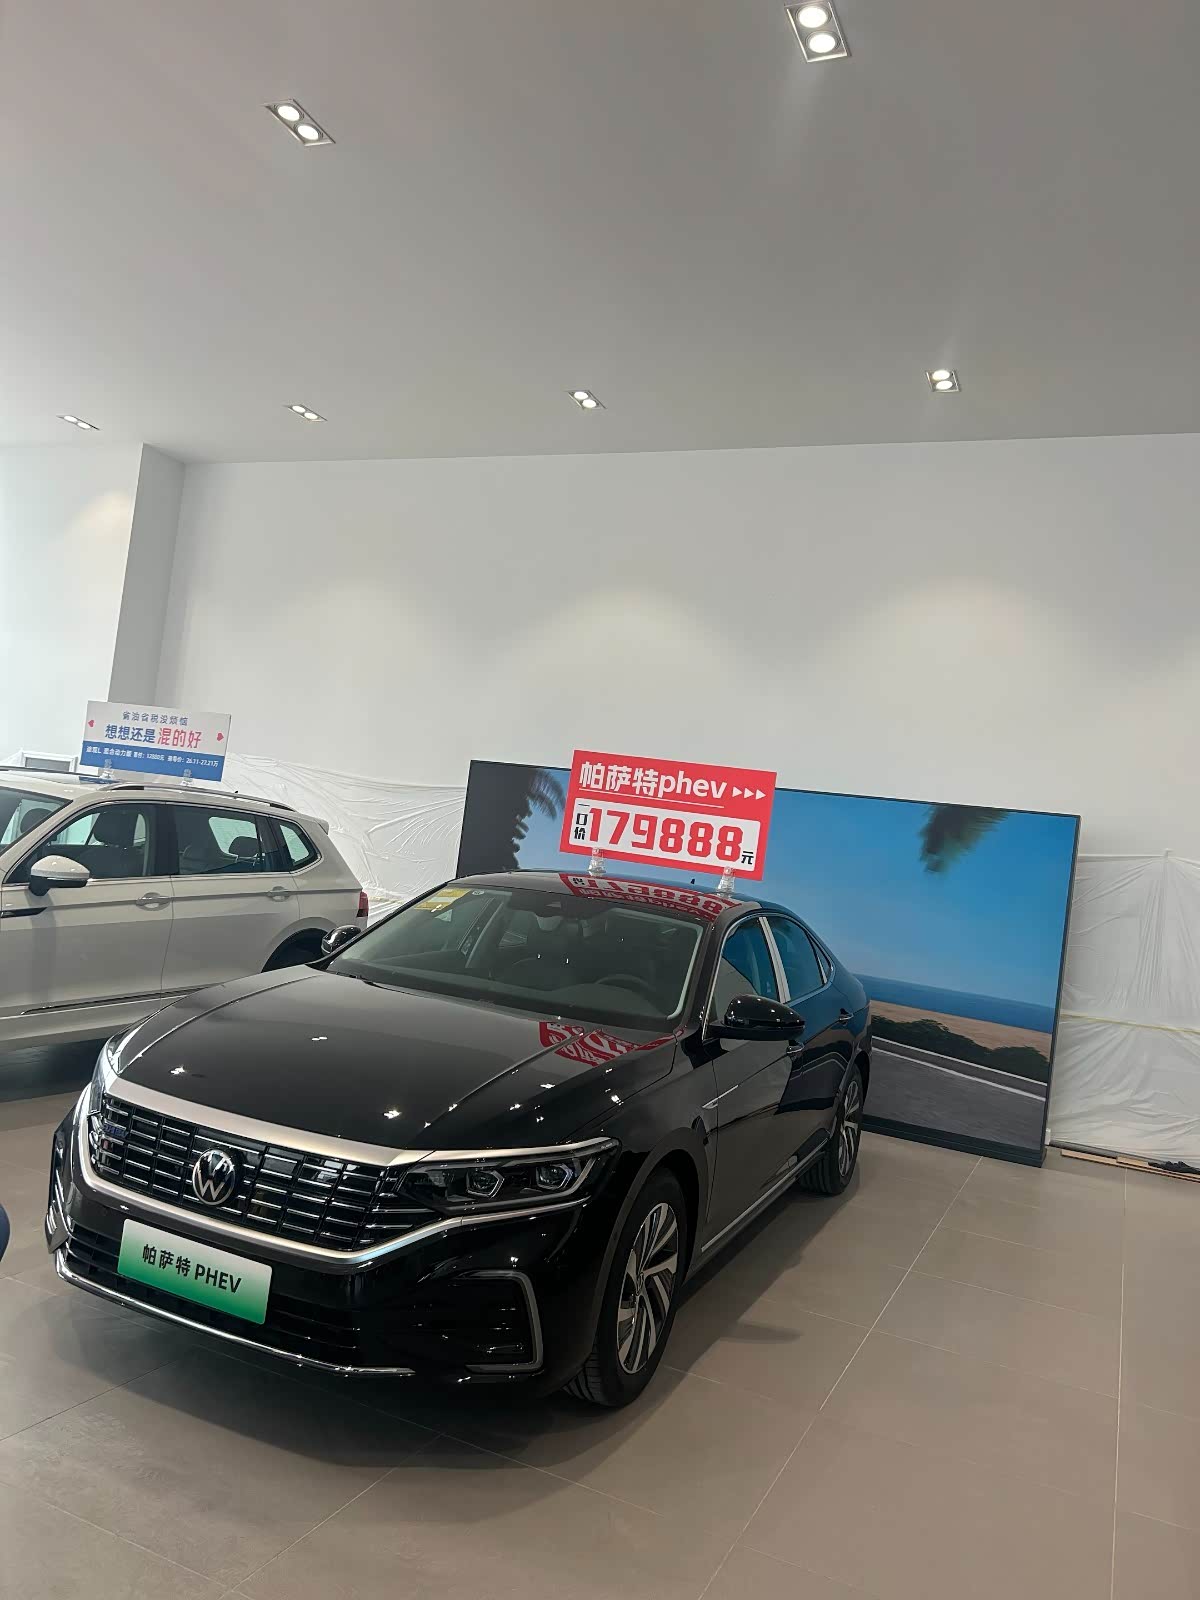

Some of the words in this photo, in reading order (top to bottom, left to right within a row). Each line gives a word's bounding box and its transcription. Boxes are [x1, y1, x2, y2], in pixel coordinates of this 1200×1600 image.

[122, 710, 188, 726] 省油省税没烦恼
[142, 1244, 191, 1277] 帕萨特
[194, 1263, 242, 1294] PHEV
